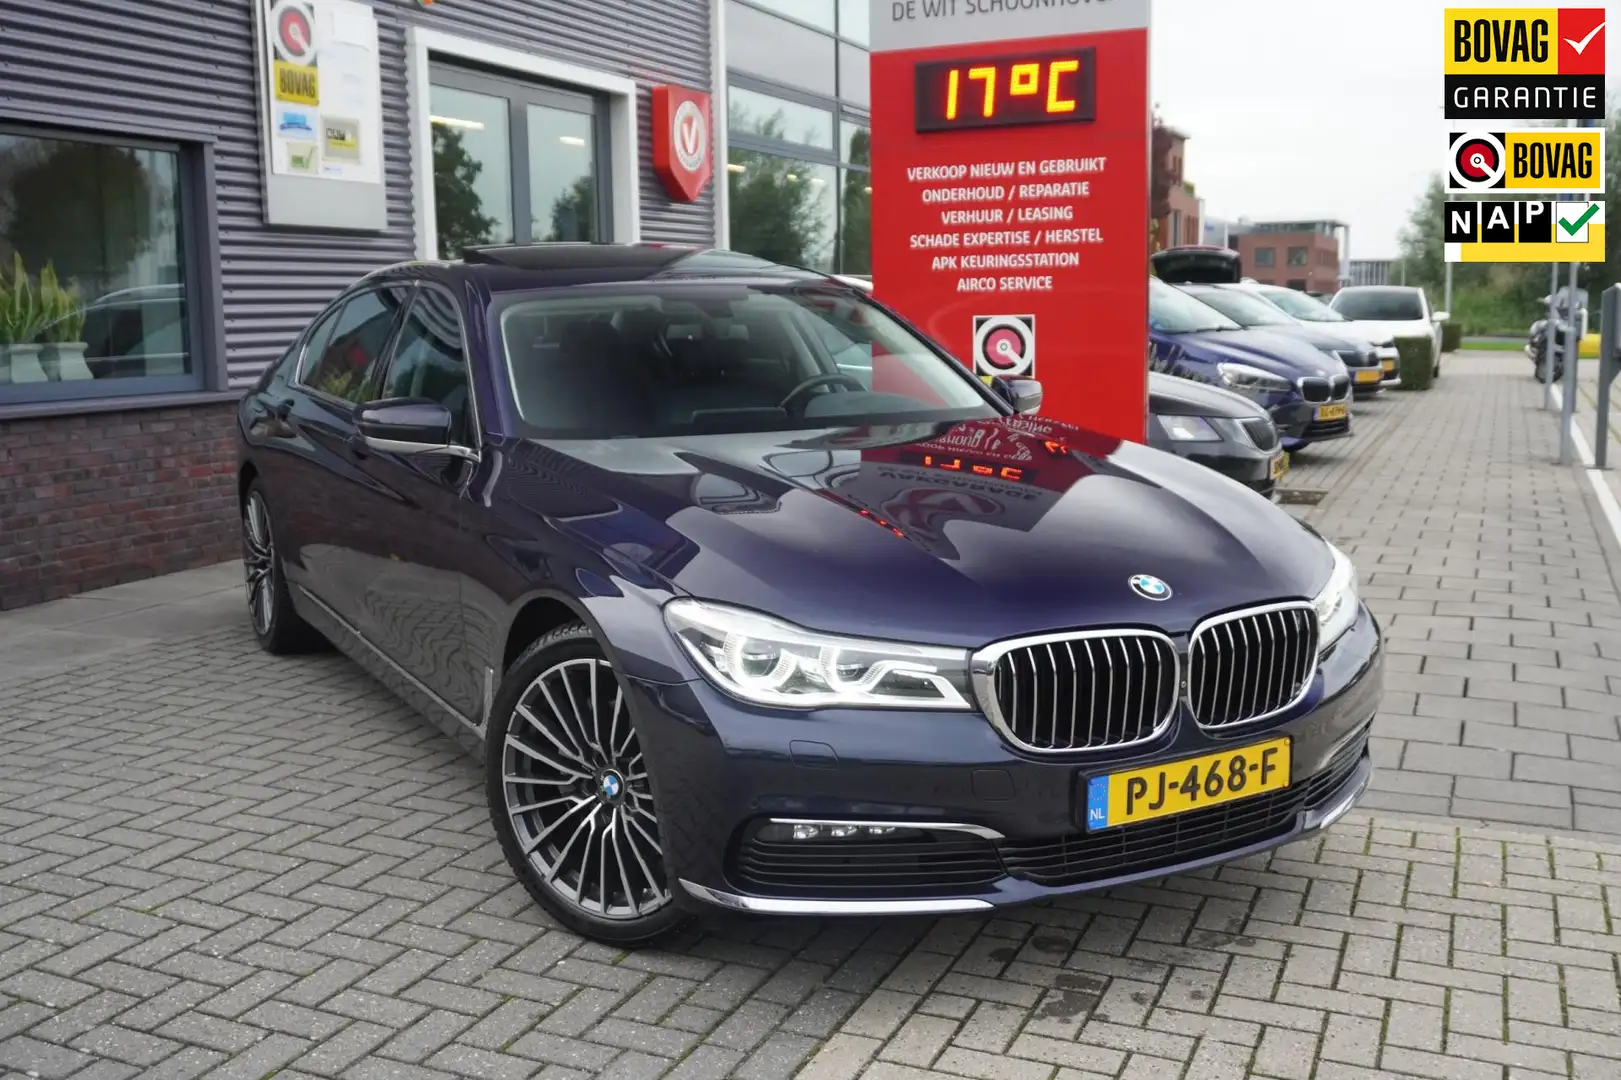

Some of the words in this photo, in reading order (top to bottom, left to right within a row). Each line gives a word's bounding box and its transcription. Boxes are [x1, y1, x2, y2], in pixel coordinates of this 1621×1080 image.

[892, 0, 917, 21] DE
[922, 0, 956, 18] WIT
[279, 67, 317, 99] BOVAG
[907, 164, 967, 182] VERKOOP
[970, 161, 1015, 178] NIEUW
[1018, 160, 1036, 176] EN
[1039, 156, 1107, 175] GEBRUIKT
[922, 185, 1005, 204] ONDERHOUD
[1008, 185, 1016, 201] /
[1019, 181, 1090, 198] REPARATIE
[941, 209, 1004, 225] VERHUUR
[1006, 208, 1015, 224] /
[1017, 205, 1074, 222] LEASING
[910, 232, 960, 249] SCHADE
[963, 230, 1031, 246] EXPERTISE
[1034, 230, 1042, 246] /
[1045, 227, 1104, 244] HERSTEL
[931, 255, 958, 271] APK
[960, 251, 1080, 270] KEURINGSSTATION
[956, 277, 996, 292] AIRCO
[999, 275, 1053, 291] SERVICE
[1126, 746, 1278, 816] PJ-468-F
[1089, 809, 1105, 820] NL
